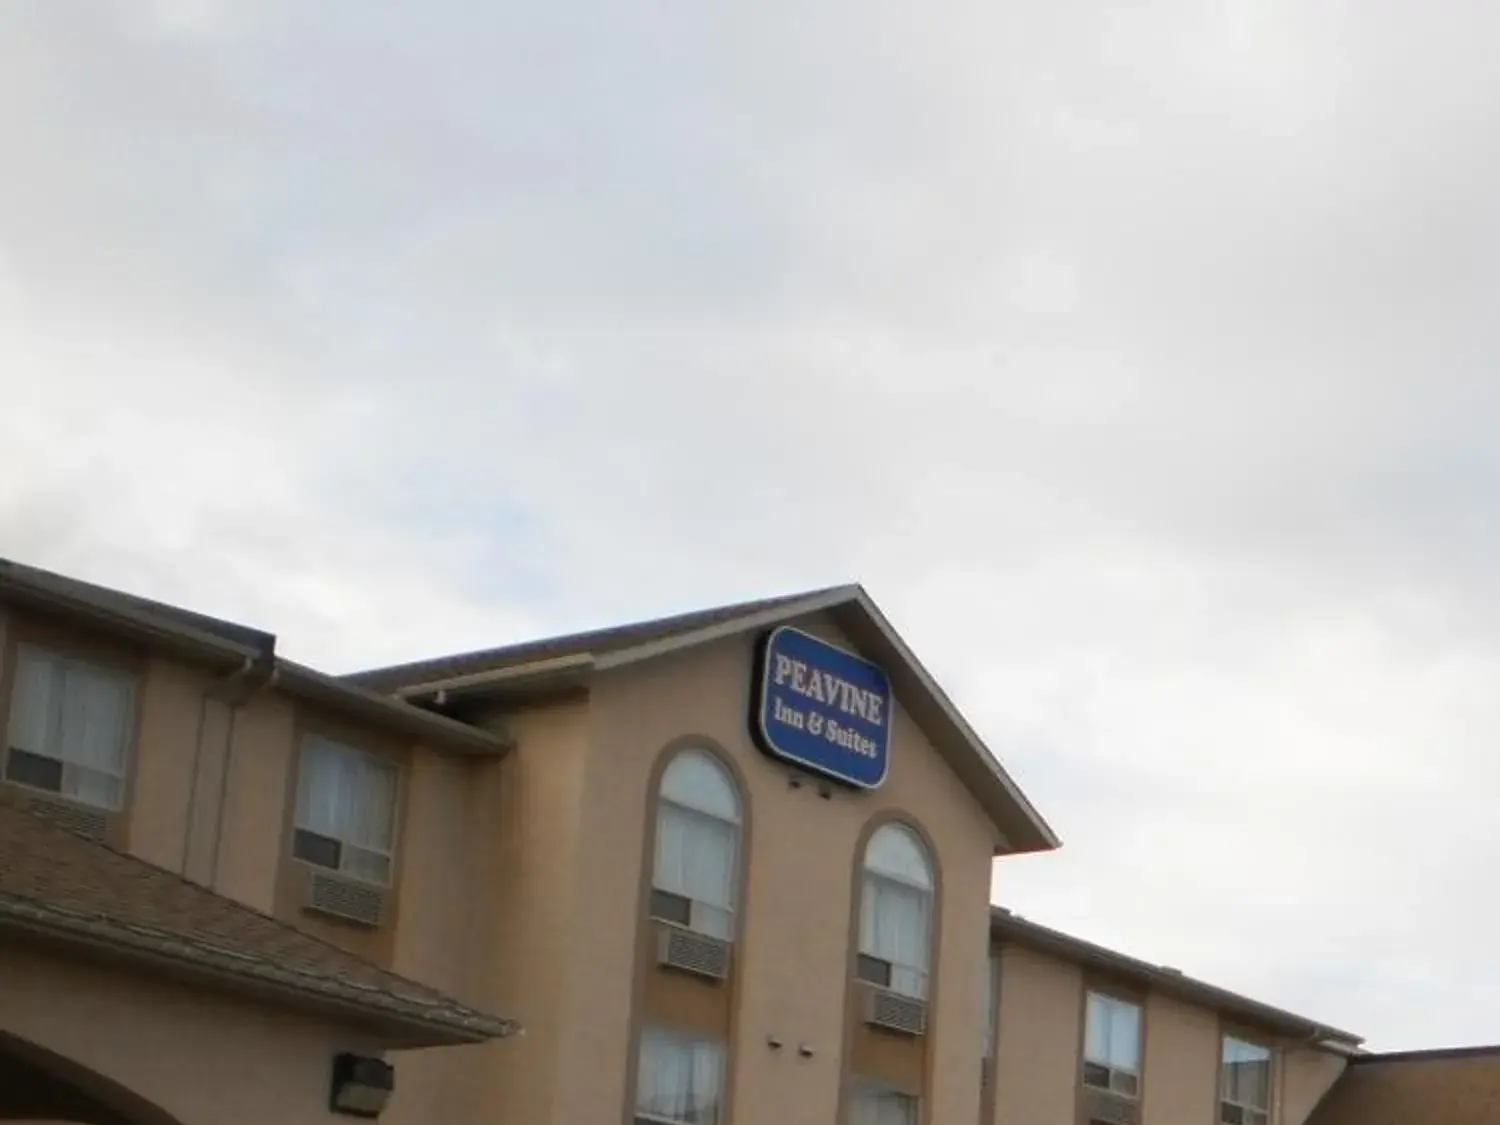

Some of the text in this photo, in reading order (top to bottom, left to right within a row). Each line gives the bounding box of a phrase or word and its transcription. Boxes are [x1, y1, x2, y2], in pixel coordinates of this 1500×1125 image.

[774, 653, 884, 726] PEAVINE
[774, 697, 877, 759] Inn & Suites
